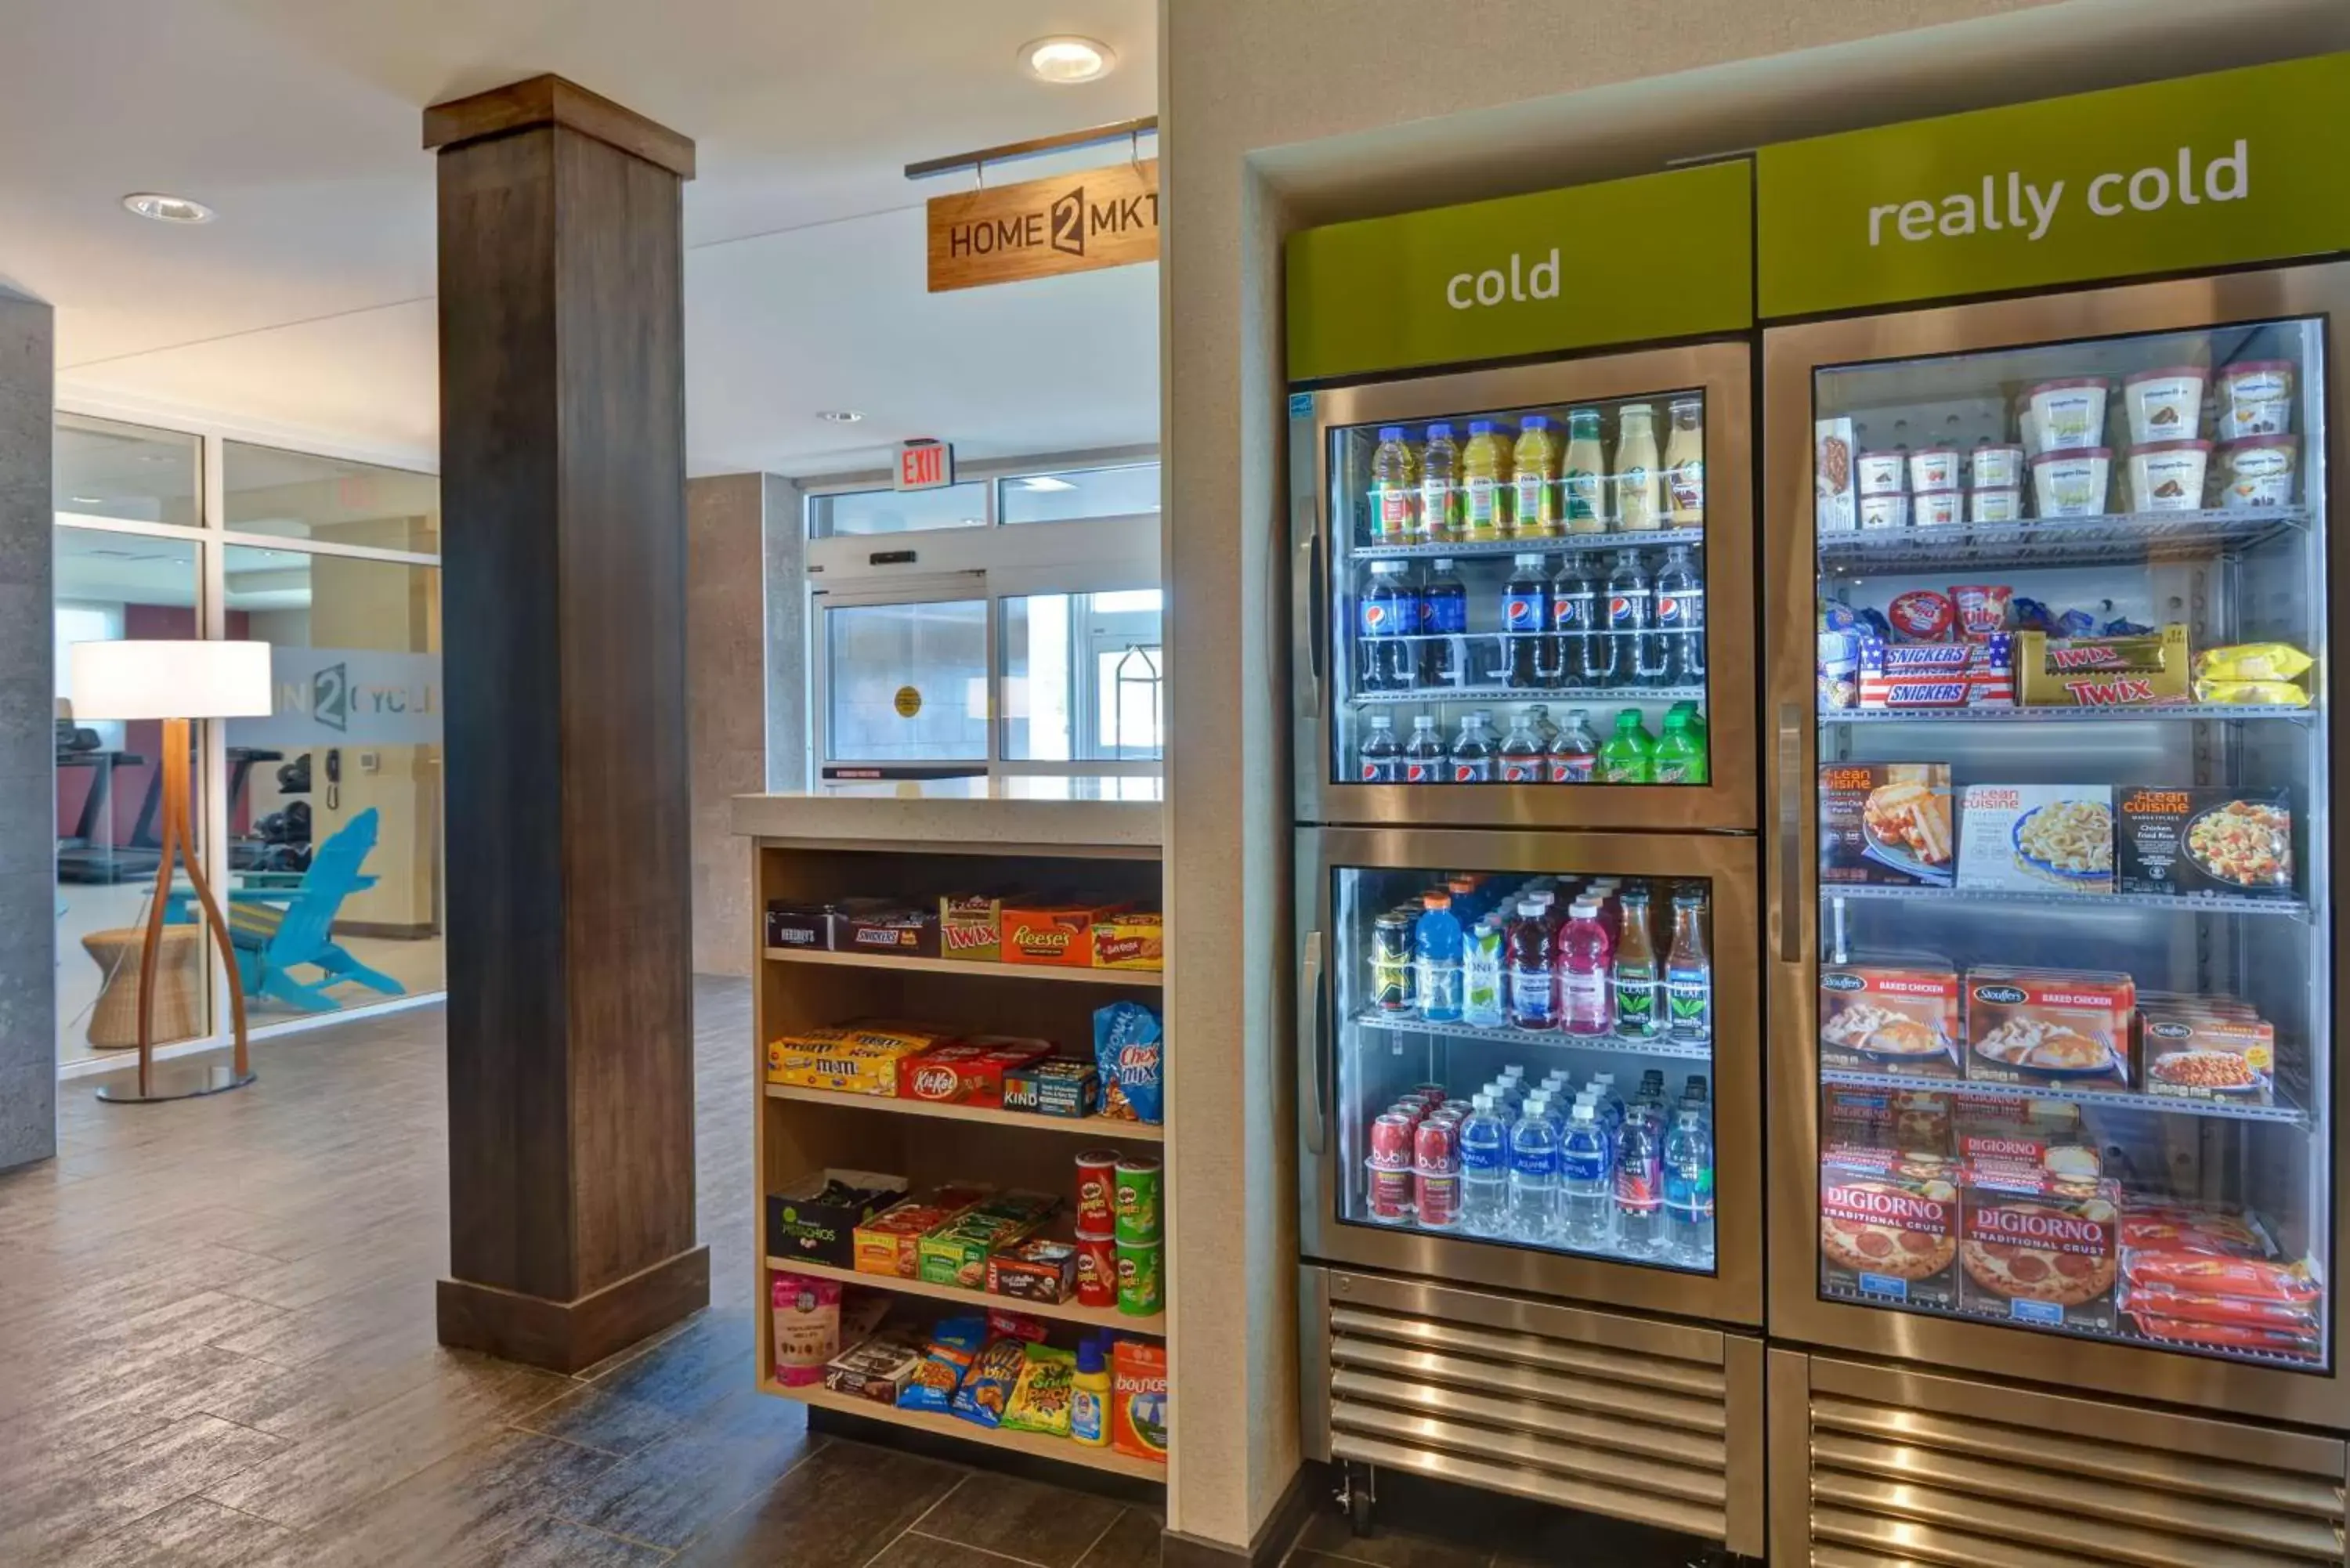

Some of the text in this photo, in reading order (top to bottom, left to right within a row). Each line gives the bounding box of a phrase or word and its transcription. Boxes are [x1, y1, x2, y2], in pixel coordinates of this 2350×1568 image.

[1869, 139, 2249, 247] really cold
[950, 212, 1045, 259] HOME
[1091, 193, 1159, 237] MKT
[1446, 247, 1561, 311] cold
[902, 447, 942, 485] EXIT
[1887, 647, 1965, 664] SNICKERS
[1889, 684, 1963, 702] SNICKERS
[1879, 981, 1944, 993] BAKED CHICKEN
[2042, 994, 2113, 1006] BAKED CHICKEN
[1120, 1045, 1159, 1066] Chex
[1004, 1091, 1038, 1107] KIND
[1828, 1186, 1943, 1220] DIGIORNO
[1824, 1208, 1946, 1234] TRADITIONAL CRUST
[1977, 1209, 2103, 1242] DIGIORNO
[1972, 1230, 2106, 1255] TRADITIONAL CRUST
